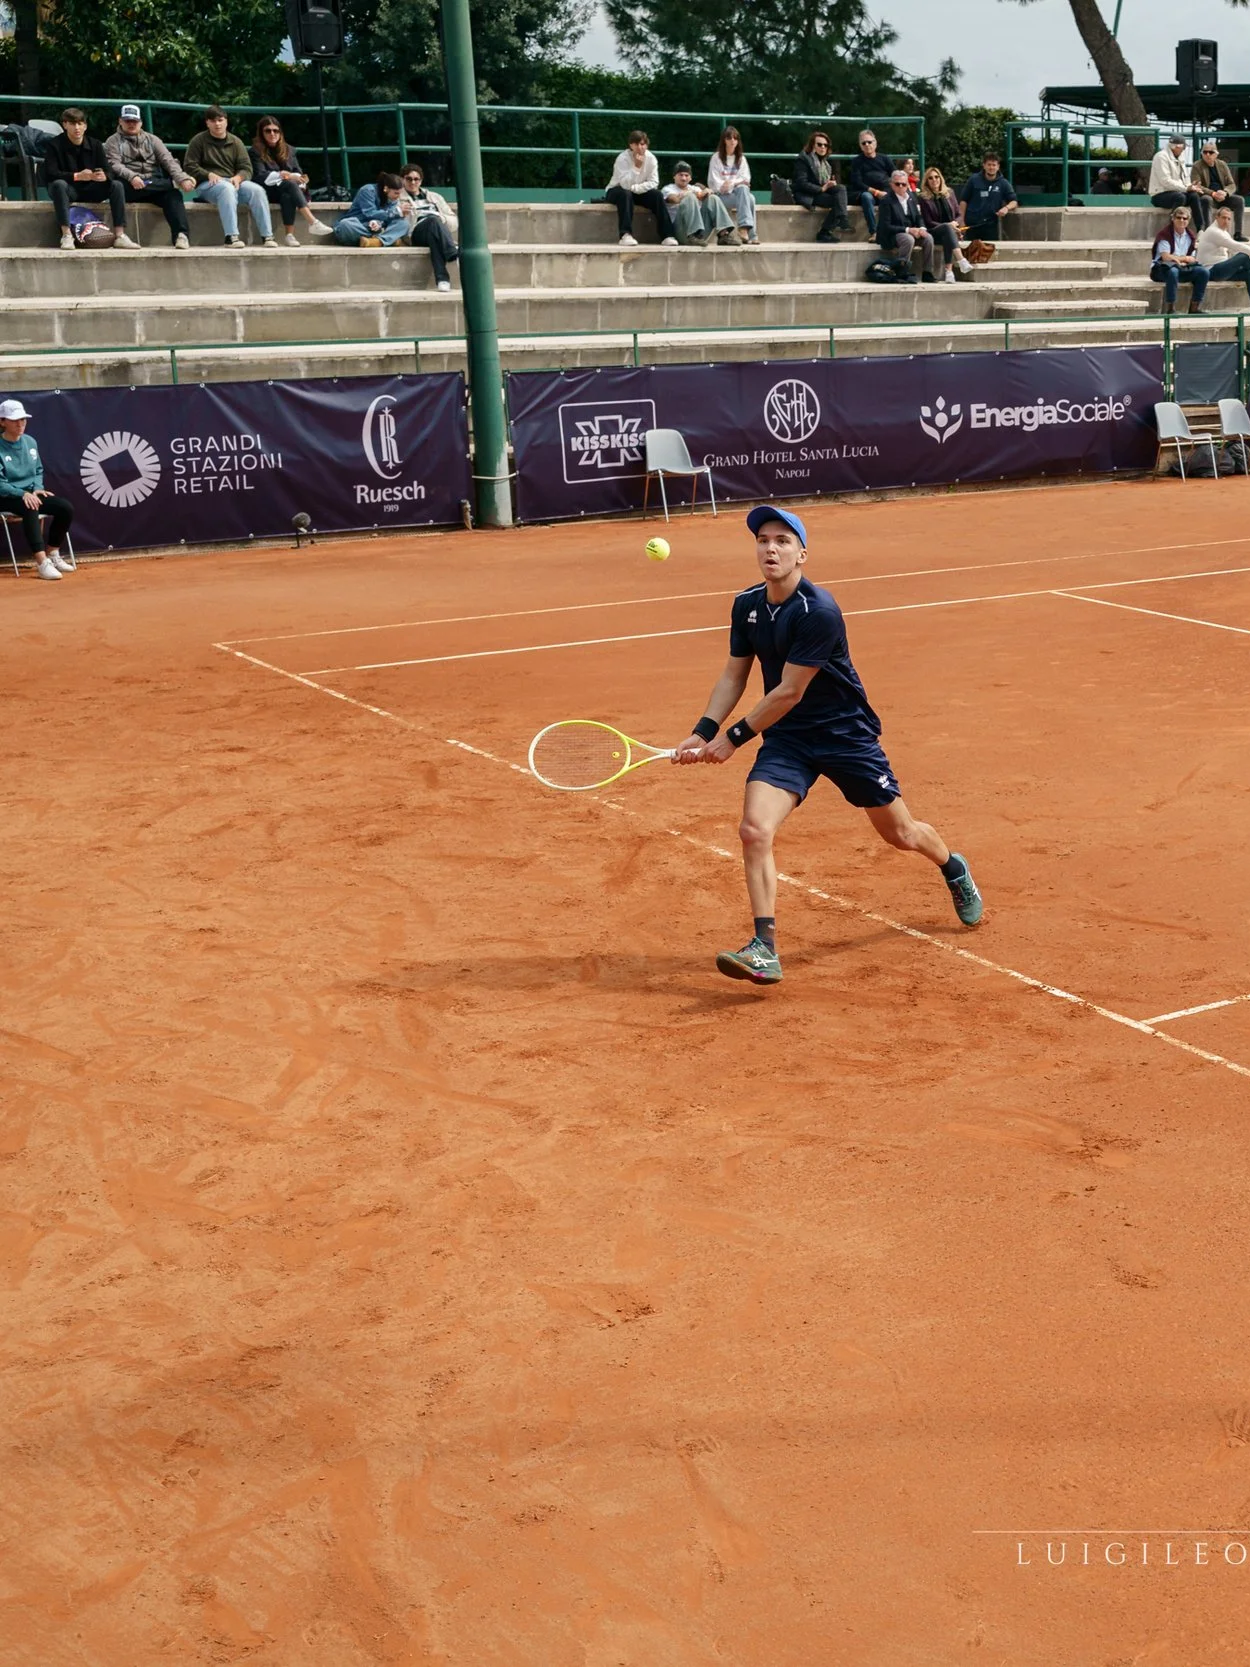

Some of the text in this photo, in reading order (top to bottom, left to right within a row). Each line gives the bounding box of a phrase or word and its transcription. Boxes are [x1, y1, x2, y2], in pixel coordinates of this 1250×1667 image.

[170, 434, 262, 455] GRANDI
[172, 453, 283, 475] STAZIONI
[174, 474, 255, 494] RETAIL
[355, 480, 426, 504] Ruesch
